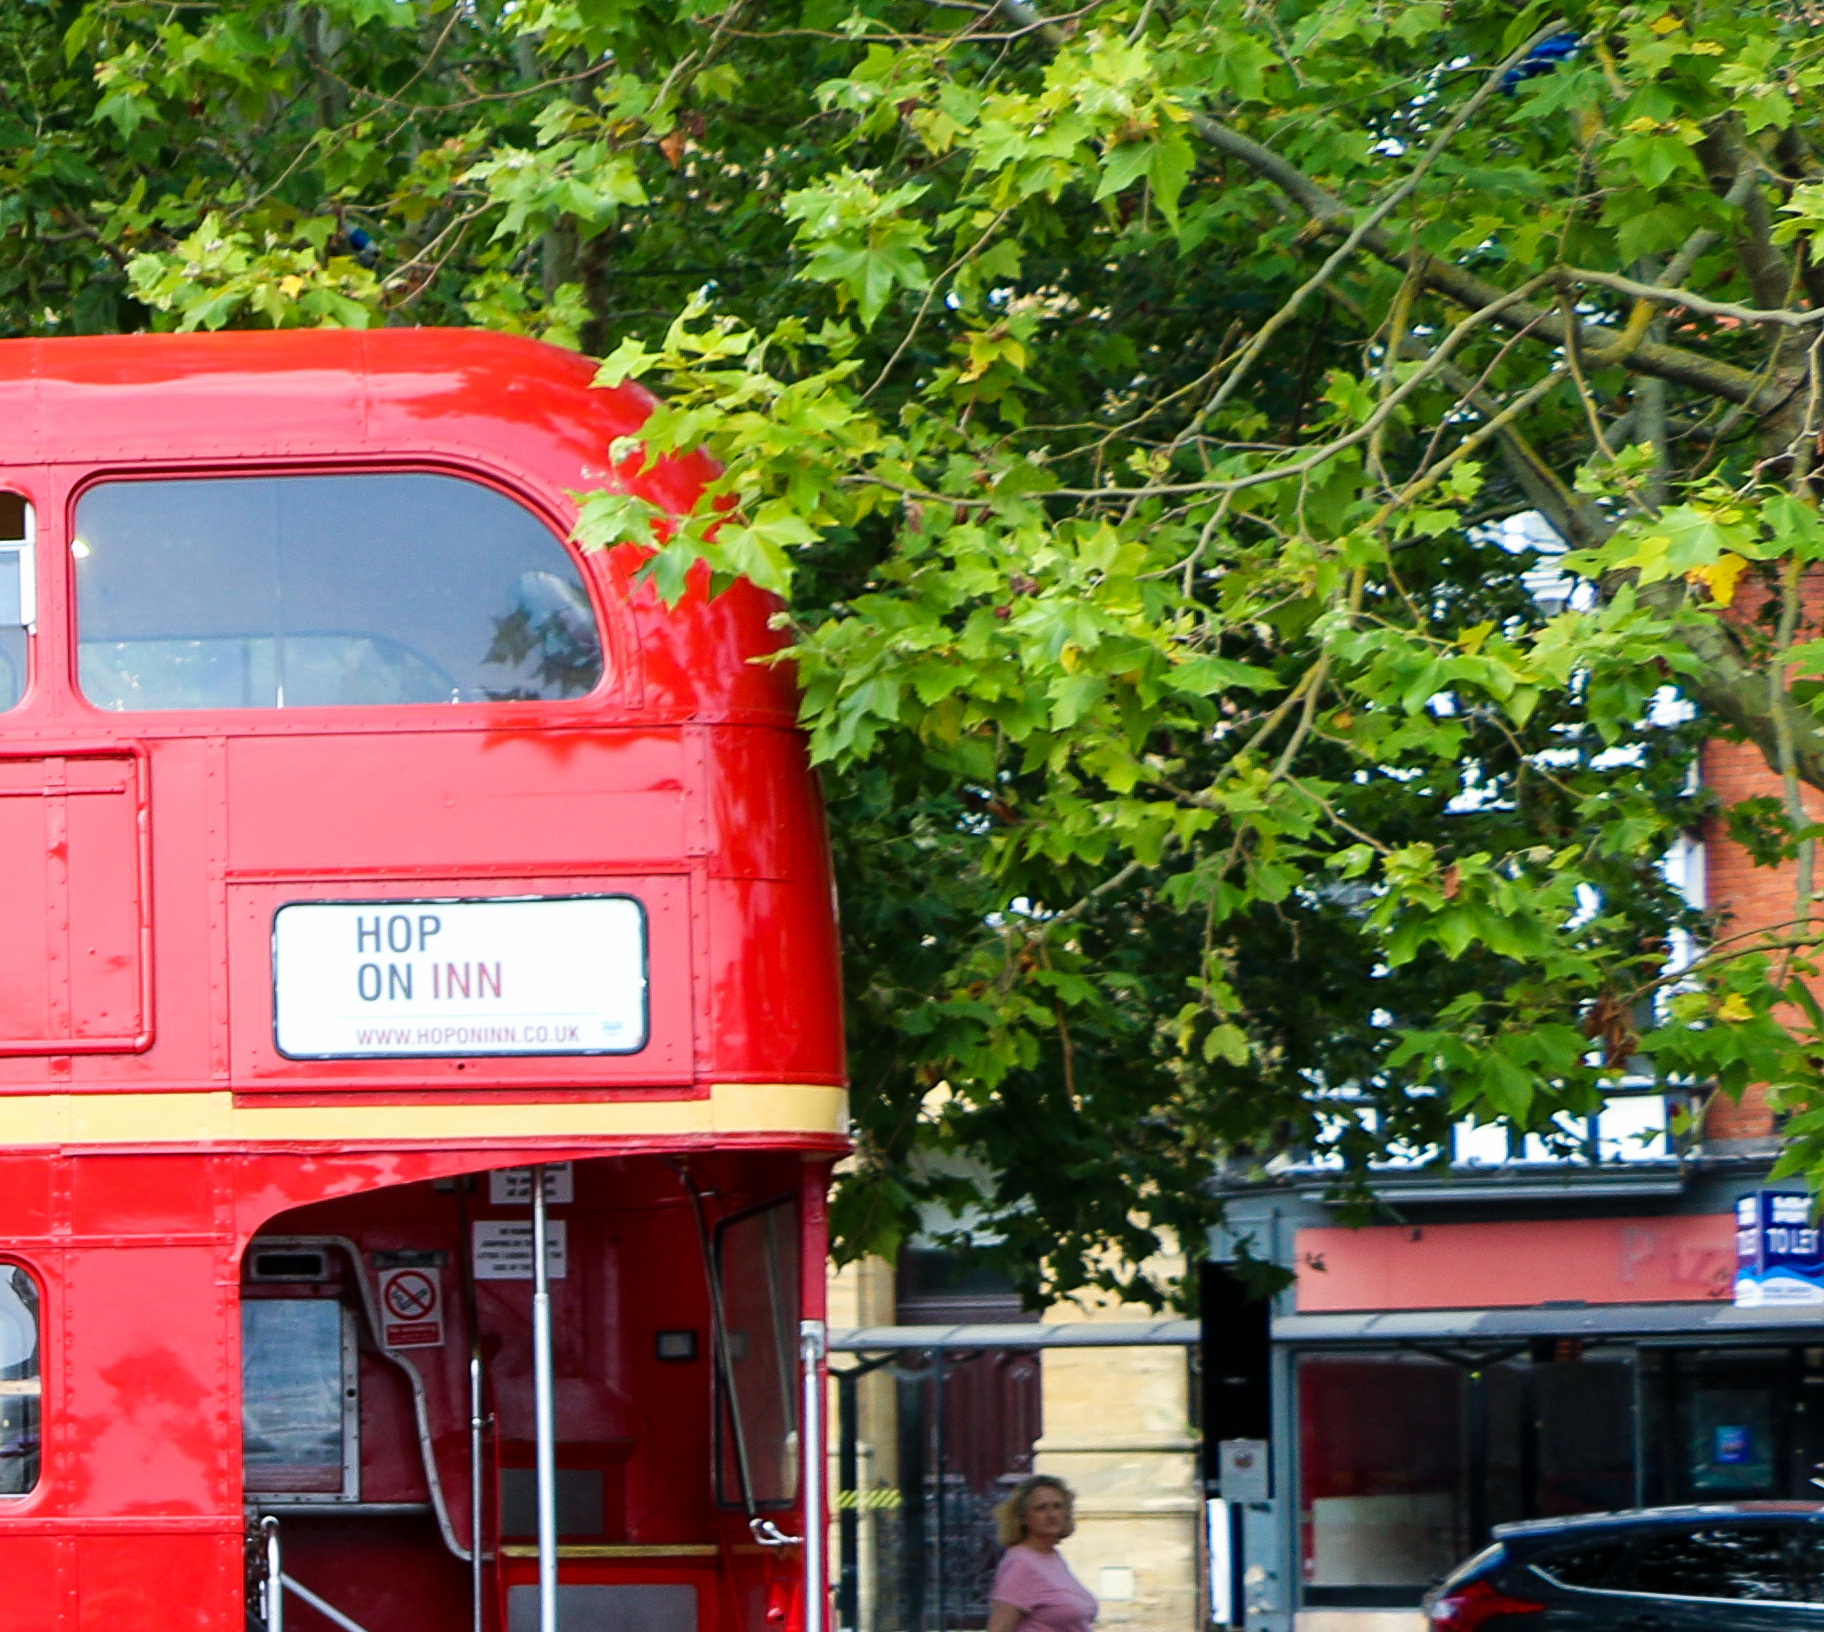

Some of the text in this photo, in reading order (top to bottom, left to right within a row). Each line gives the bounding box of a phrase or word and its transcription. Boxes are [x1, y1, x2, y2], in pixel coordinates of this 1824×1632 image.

[356, 914, 443, 953] HOP
[357, 961, 503, 1002] ON INN
[355, 1024, 581, 1046] WWW.HOPONINN.CO.UK
